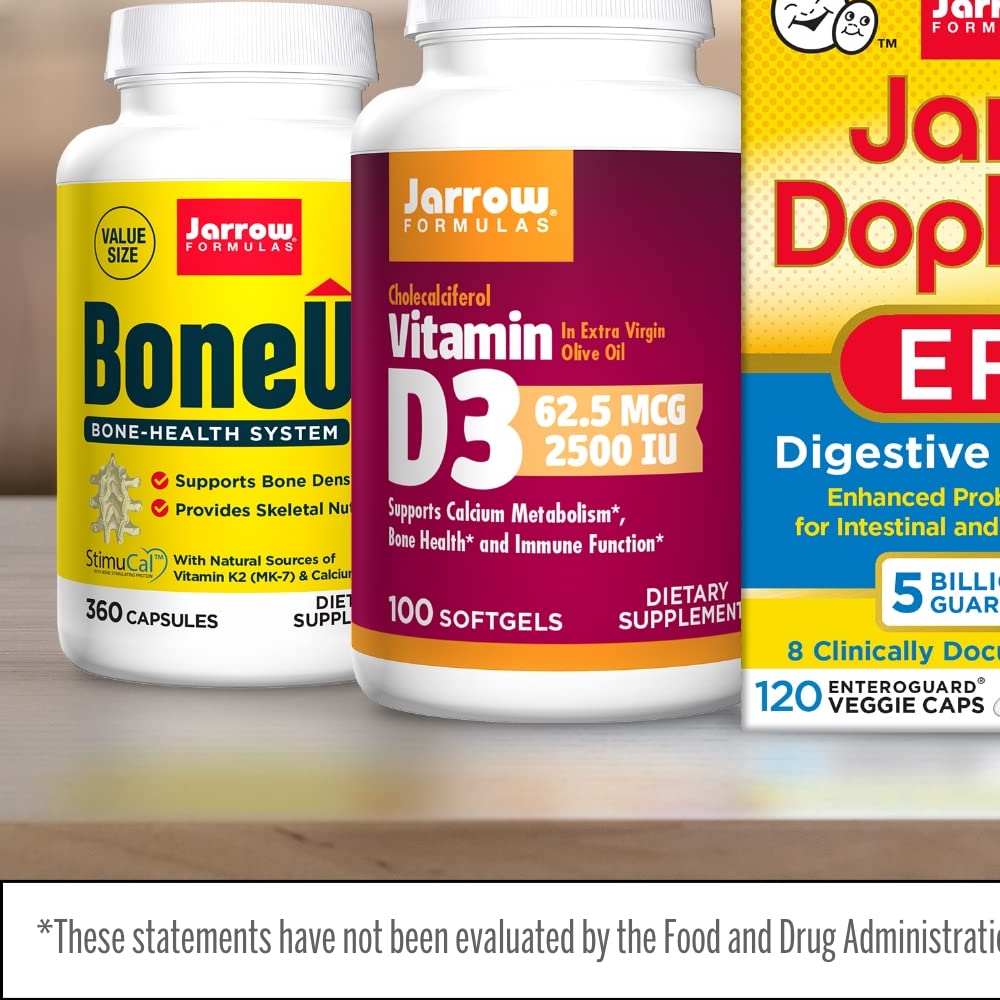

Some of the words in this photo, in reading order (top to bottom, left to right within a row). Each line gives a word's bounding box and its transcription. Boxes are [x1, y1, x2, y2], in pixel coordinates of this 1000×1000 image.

[102, 227, 146, 244] VALUE
[404, 217, 549, 233] FORMULAS
[107, 247, 139, 264] SIZE
[186, 241, 293, 252] FORMULAS
[389, 284, 491, 306] Cholecalciferol
[388, 309, 553, 361] Vitamin
[561, 322, 575, 340] In
[580, 322, 620, 340] Extra
[625, 322, 666, 343] Virgin
[84, 301, 351, 410] BoneU
[561, 344, 600, 362] Olive
[605, 342, 626, 361] Oil
[535, 394, 611, 427] 62.5
[621, 393, 686, 426] MCG
[91, 422, 239, 441] BONE-HEALTH
[250, 425, 338, 441] SYSTEM
[388, 368, 523, 490] D3
[545, 434, 633, 467] 2500
[641, 433, 677, 465] IU
[776, 434, 990, 476] Digestive
[175, 474, 256, 490] Supports
[262, 475, 307, 488] Bone
[828, 487, 945, 507] Enhanced
[175, 502, 251, 517] Provides
[256, 502, 324, 517] Skeletal
[388, 497, 442, 524] Supports
[446, 501, 505, 523] Calcium
[795, 517, 829, 536] for
[837, 517, 946, 537] Intestinal
[954, 517, 999, 537] and
[388, 527, 416, 549] Bone
[480, 532, 509, 553] and
[515, 534, 583, 554] Immune
[173, 554, 206, 566] With
[210, 555, 261, 567] Natural
[265, 555, 319, 566] Sources
[322, 553, 336, 564] of
[173, 570, 225, 583] Vitamin
[228, 571, 247, 583] K2
[250, 571, 296, 584] (MK-7)
[646, 582, 729, 607] DIETARY
[892, 572, 923, 614] 5
[86, 598, 123, 623] 360
[126, 610, 219, 629] CAPSULES
[389, 596, 434, 626] 100
[439, 610, 563, 631] SOFTGELS
[787, 641, 803, 661] 8
[813, 640, 934, 665] Clinically
[756, 680, 822, 713] 120
[828, 697, 916, 714] VEGGIE
[922, 697, 985, 714] CAPS
